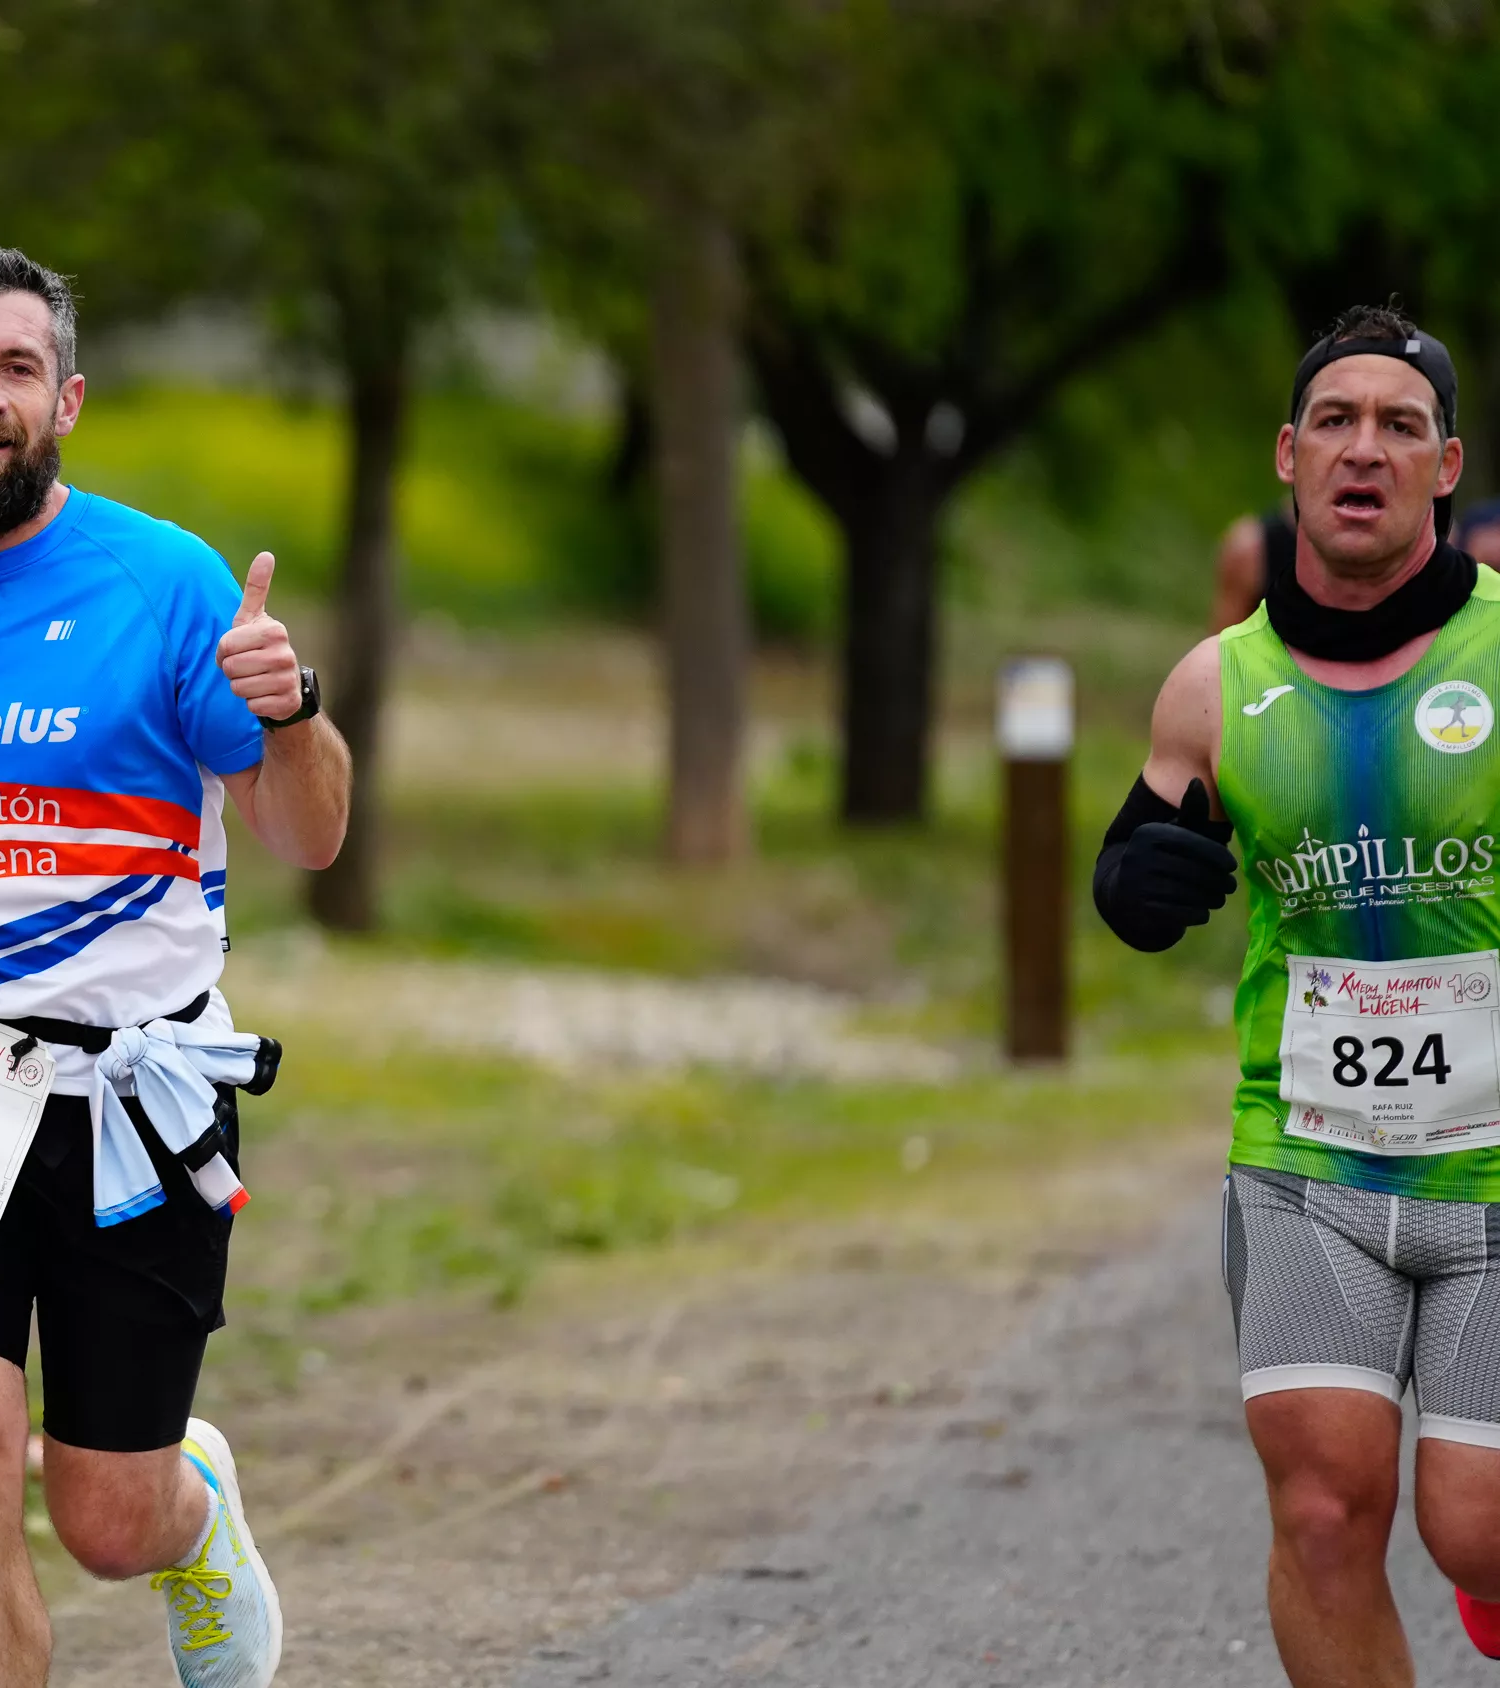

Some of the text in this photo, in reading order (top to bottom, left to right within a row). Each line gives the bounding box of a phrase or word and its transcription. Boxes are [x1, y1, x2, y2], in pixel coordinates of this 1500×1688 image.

[1332, 885, 1375, 899] QUE
[1380, 876, 1494, 896] NECESITAS
[1359, 995, 1429, 1016] LUCENA
[1332, 1033, 1452, 1087] 824
[1372, 1103, 1393, 1111] RAFA
[1372, 1113, 1415, 1121] M-Hombre
